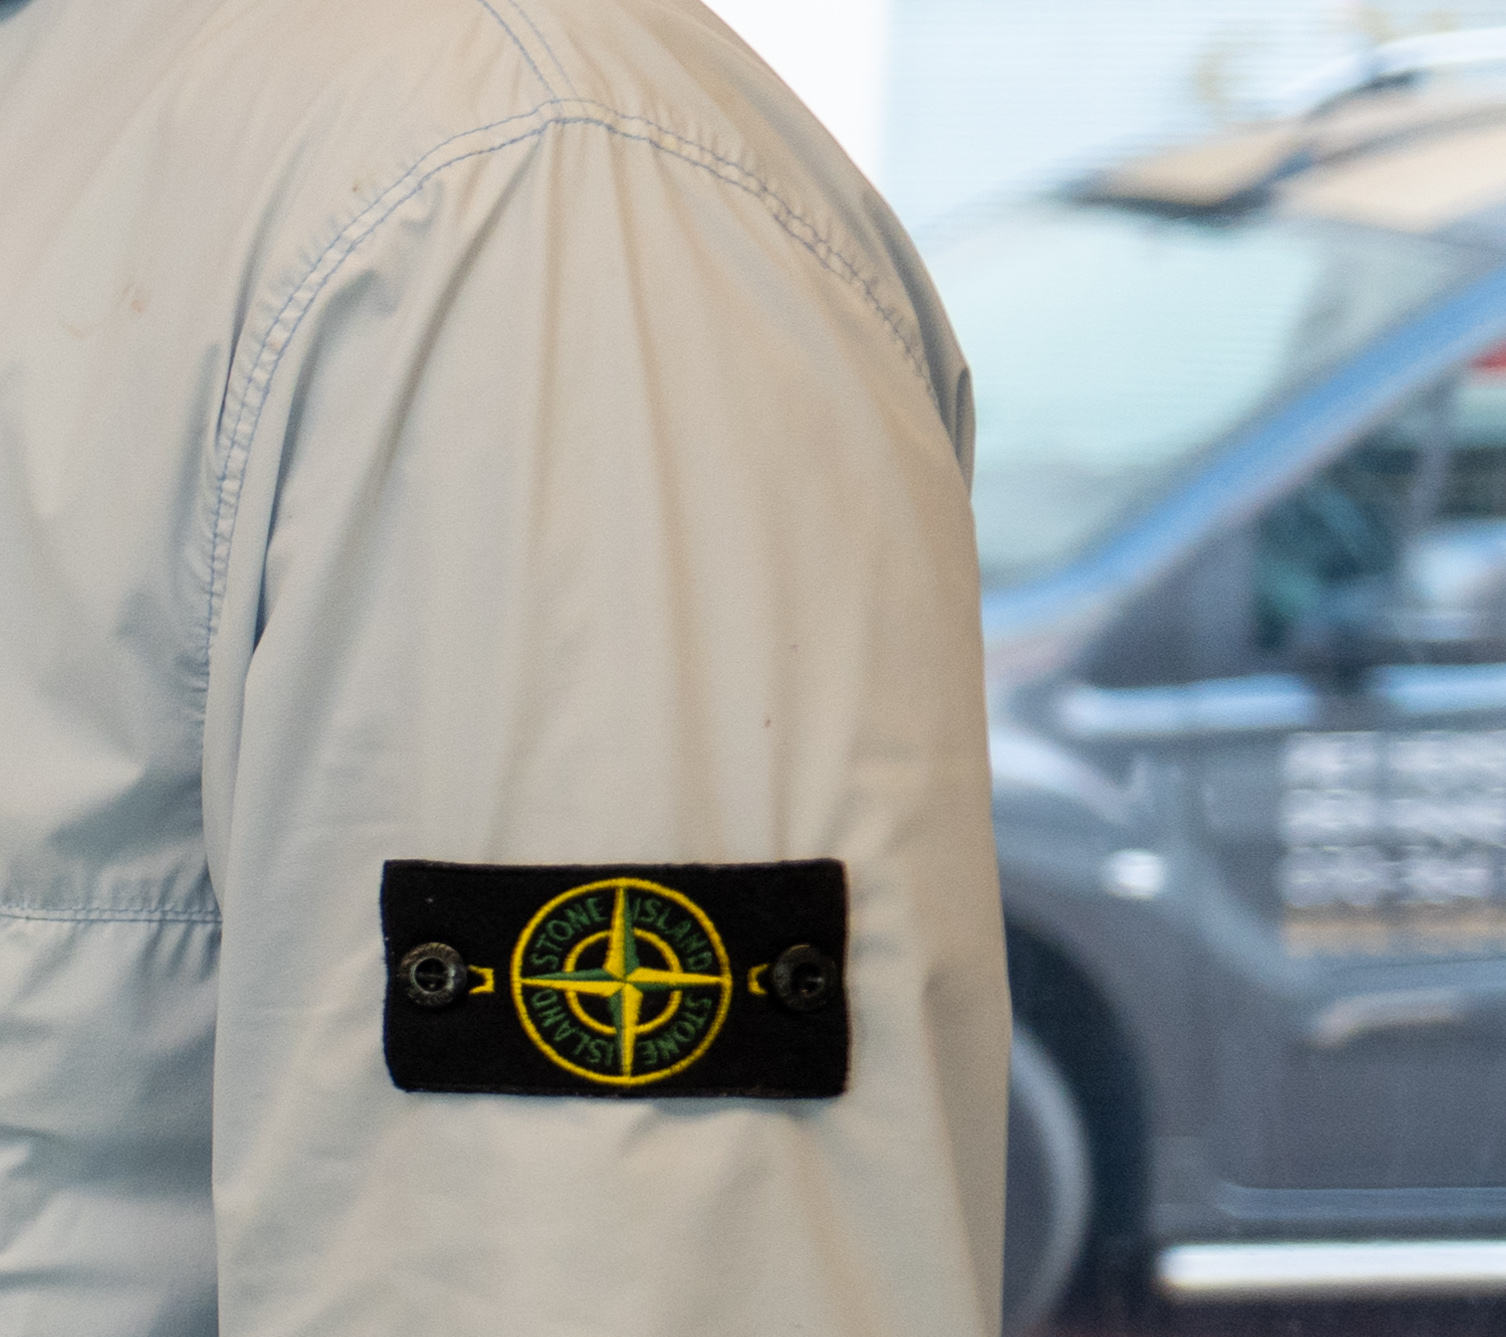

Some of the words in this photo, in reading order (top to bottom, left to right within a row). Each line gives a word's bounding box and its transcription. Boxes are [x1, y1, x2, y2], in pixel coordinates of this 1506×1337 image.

[530, 896, 608, 970] STONE
[632, 897, 712, 971] ISLAND
[532, 989, 615, 1064] ISLAND
[638, 993, 712, 1064] STONE
